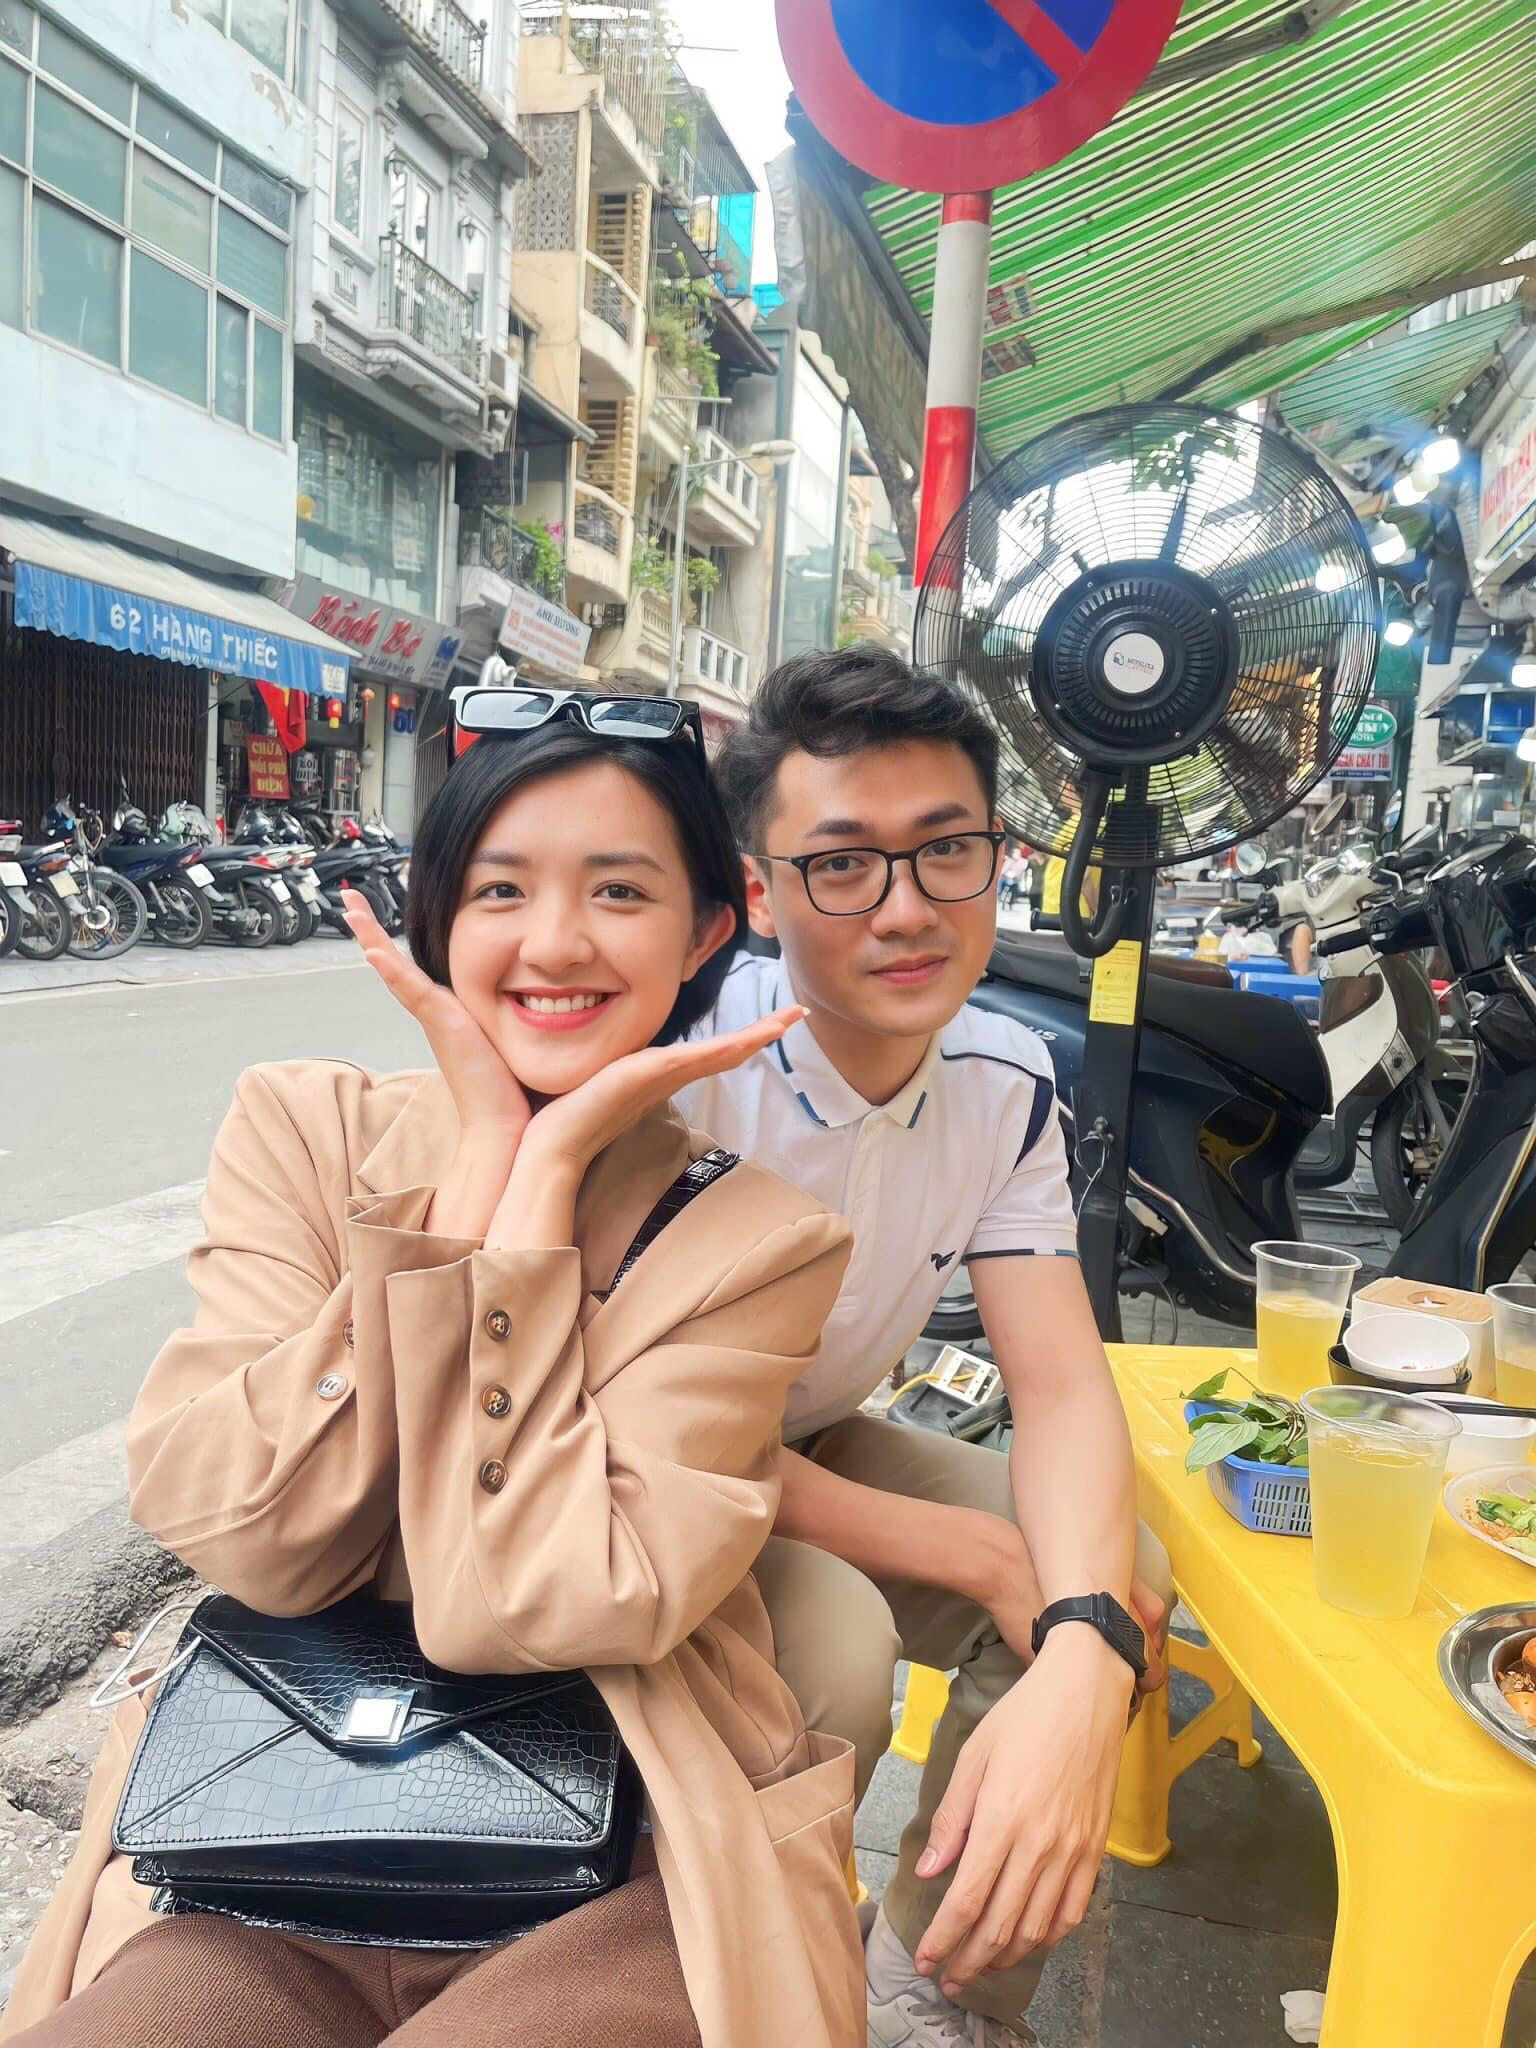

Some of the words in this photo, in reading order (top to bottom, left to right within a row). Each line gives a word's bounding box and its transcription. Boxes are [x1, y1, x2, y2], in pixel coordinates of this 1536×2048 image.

[110, 602, 142, 635] 62
[152, 610, 213, 654] HÀNG
[221, 632, 279, 670] THIẾC
